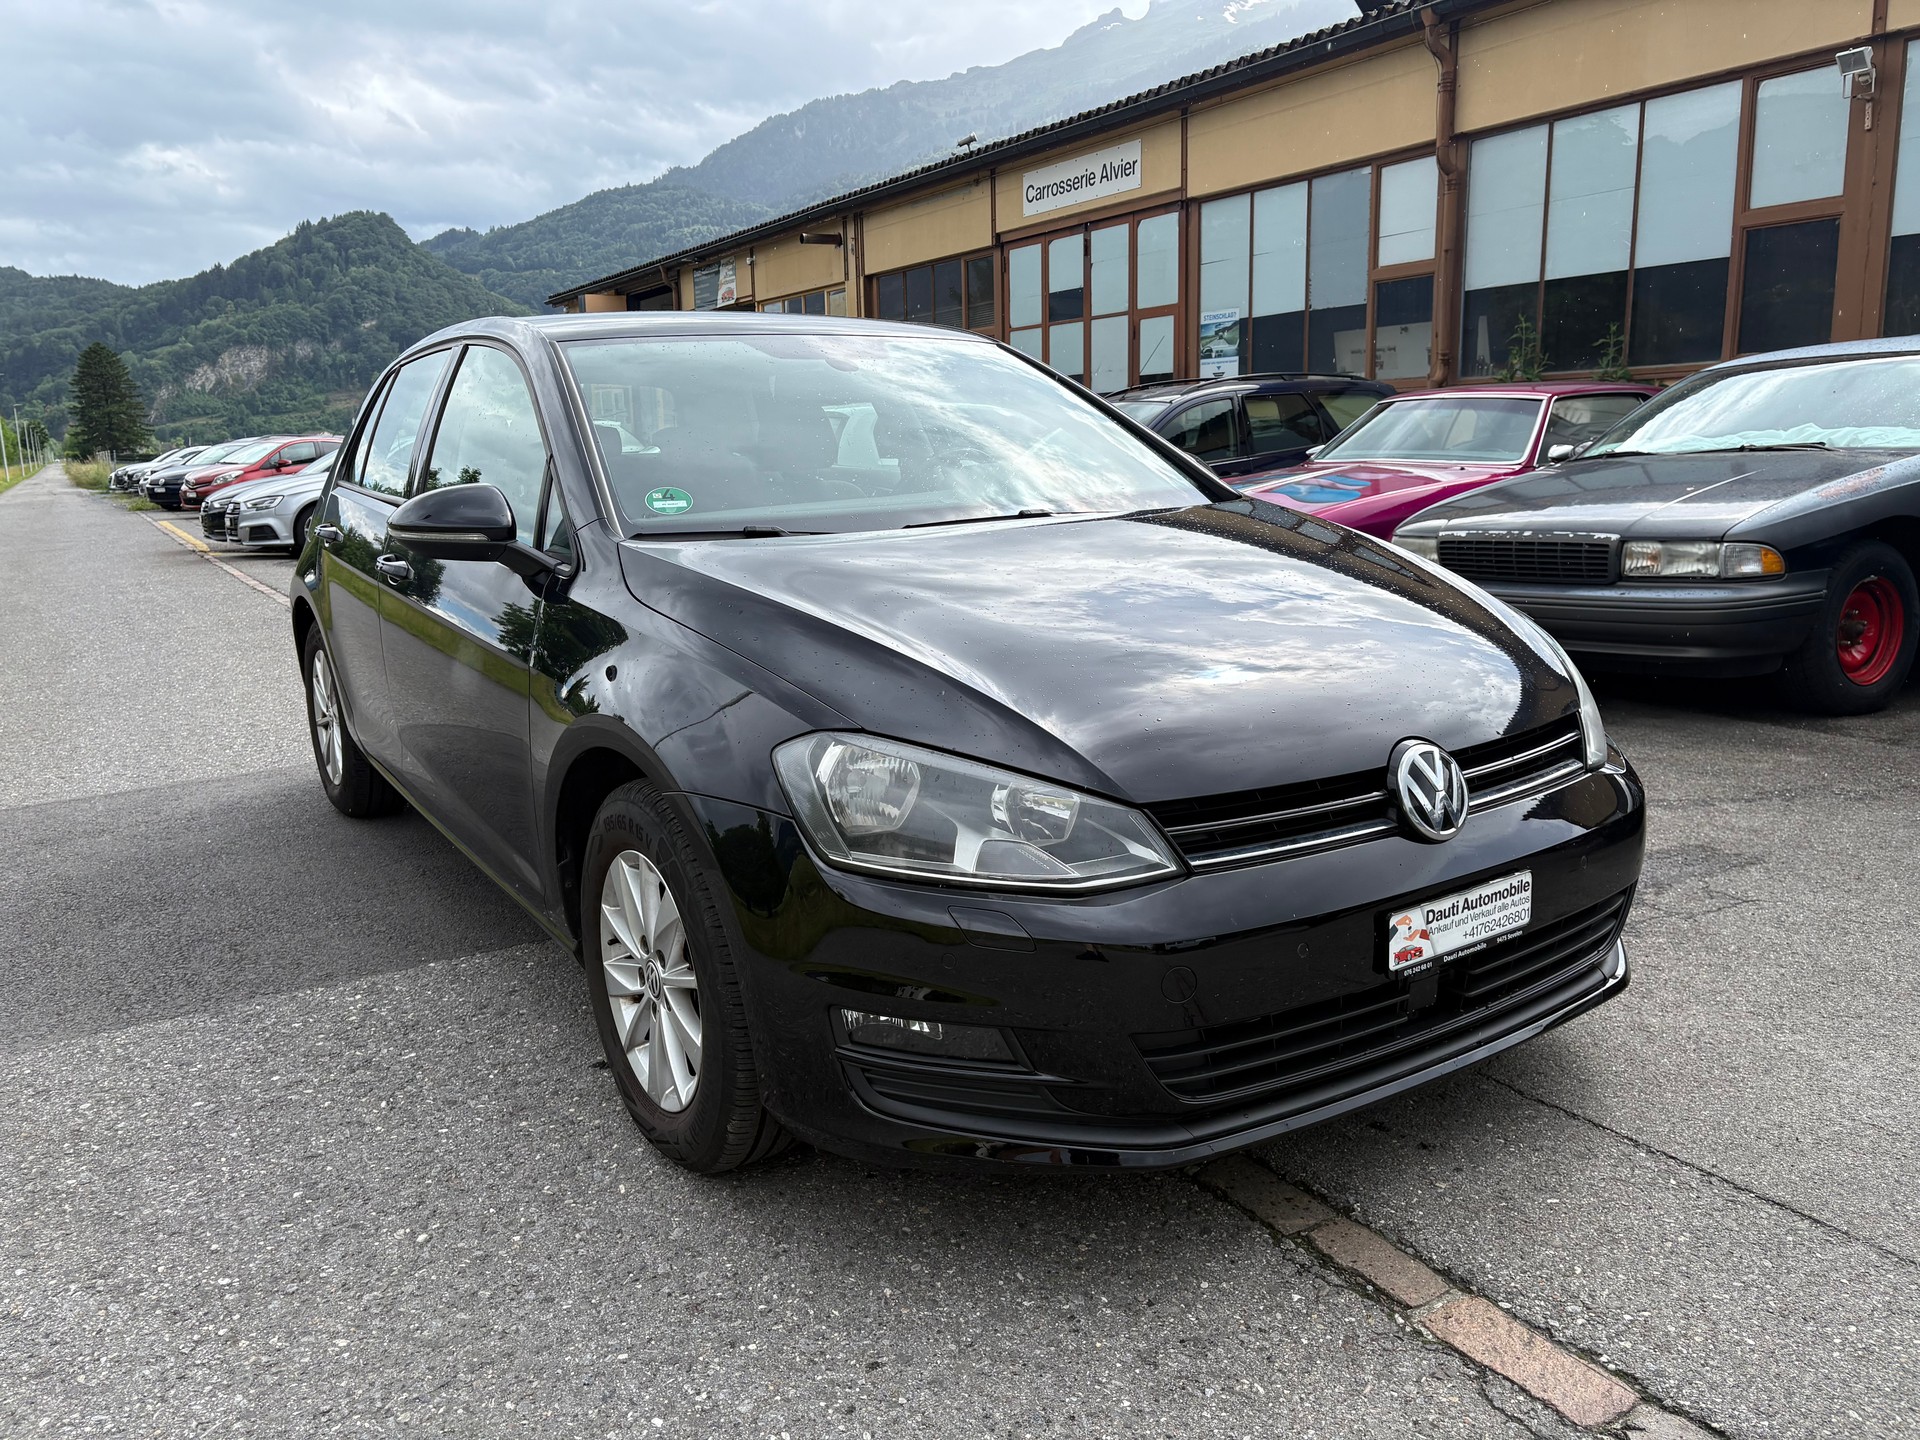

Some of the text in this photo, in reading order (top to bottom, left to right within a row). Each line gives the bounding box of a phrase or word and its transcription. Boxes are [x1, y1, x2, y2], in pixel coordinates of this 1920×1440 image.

[1025, 158, 1138, 203] Carrosserie Alvier
[662, 488, 675, 501] 4
[628, 817, 635, 835] R
[1425, 879, 1531, 925] Dauti Automobile
[1428, 895, 1530, 936] Ankauf und Verkauf alle Autos
[1462, 907, 1530, 939] +41762426801
[1443, 942, 1487, 963] Dauti Automobile
